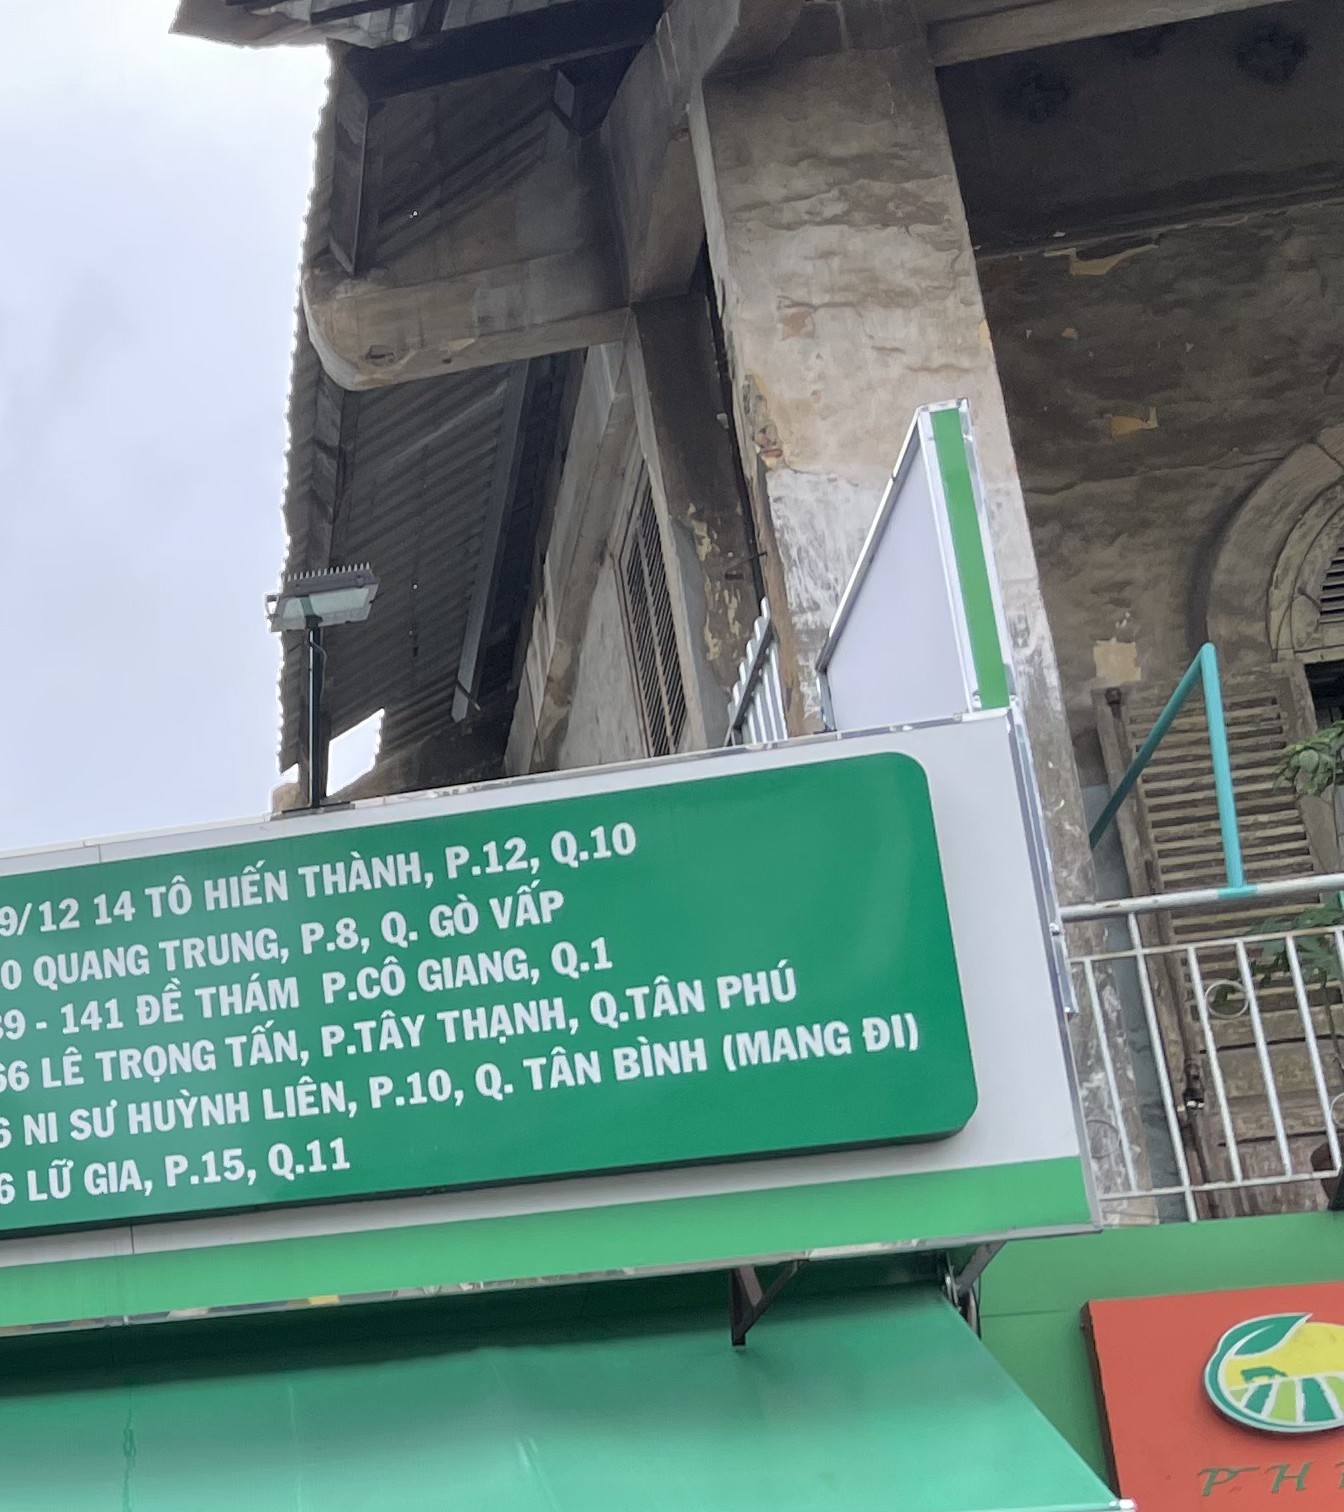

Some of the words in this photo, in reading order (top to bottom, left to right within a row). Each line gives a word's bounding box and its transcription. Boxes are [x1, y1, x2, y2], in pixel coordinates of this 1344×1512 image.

[94, 891, 135, 924] 14
[145, 875, 192, 917] TÔ
[205, 861, 288, 910] HIẾN
[298, 852, 433, 897] THÀNH,
[446, 838, 539, 878] P.12,
[552, 823, 636, 867] Q.10
[33, 944, 149, 990] QUANG
[159, 928, 289, 971] TRUNG,
[301, 918, 369, 954] P.8,
[382, 912, 417, 947] Q.
[430, 895, 478, 937] GÒ
[490, 880, 563, 928] VẤP
[61, 999, 123, 1034] 141
[136, 978, 183, 1025] ĐỀ
[195, 973, 299, 1018] THÁM
[323, 956, 405, 1003] P.CÔ
[418, 948, 539, 991] GIANG,
[552, 938, 612, 978] Q.1
[42, 1047, 84, 1088] LÊ
[95, 1040, 216, 1083] TRỌNG
[225, 1020, 309, 1067] TẤN,
[321, 1010, 424, 1056] P.TÂY
[437, 998, 578, 1043] THẠNH,
[591, 976, 705, 1028] Q.TÂN
[717, 960, 796, 1008] PHÚ
[24, 1112, 58, 1145] NI
[70, 1099, 117, 1140] SƯ
[128, 1089, 249, 1134] HUỲNH
[263, 1076, 357, 1119] LIÊN,
[369, 1069, 463, 1108] P.10,
[476, 1064, 513, 1100] Q.
[523, 1047, 601, 1090] TÂN
[613, 1037, 707, 1080] BÌNH
[723, 1021, 851, 1071] (MANG
[863, 1013, 918, 1051] ĐI)
[28, 1159, 73, 1201] LỮ
[84, 1160, 152, 1196] GIA,
[165, 1148, 256, 1187] P.15,
[268, 1138, 350, 1180] Q.11
